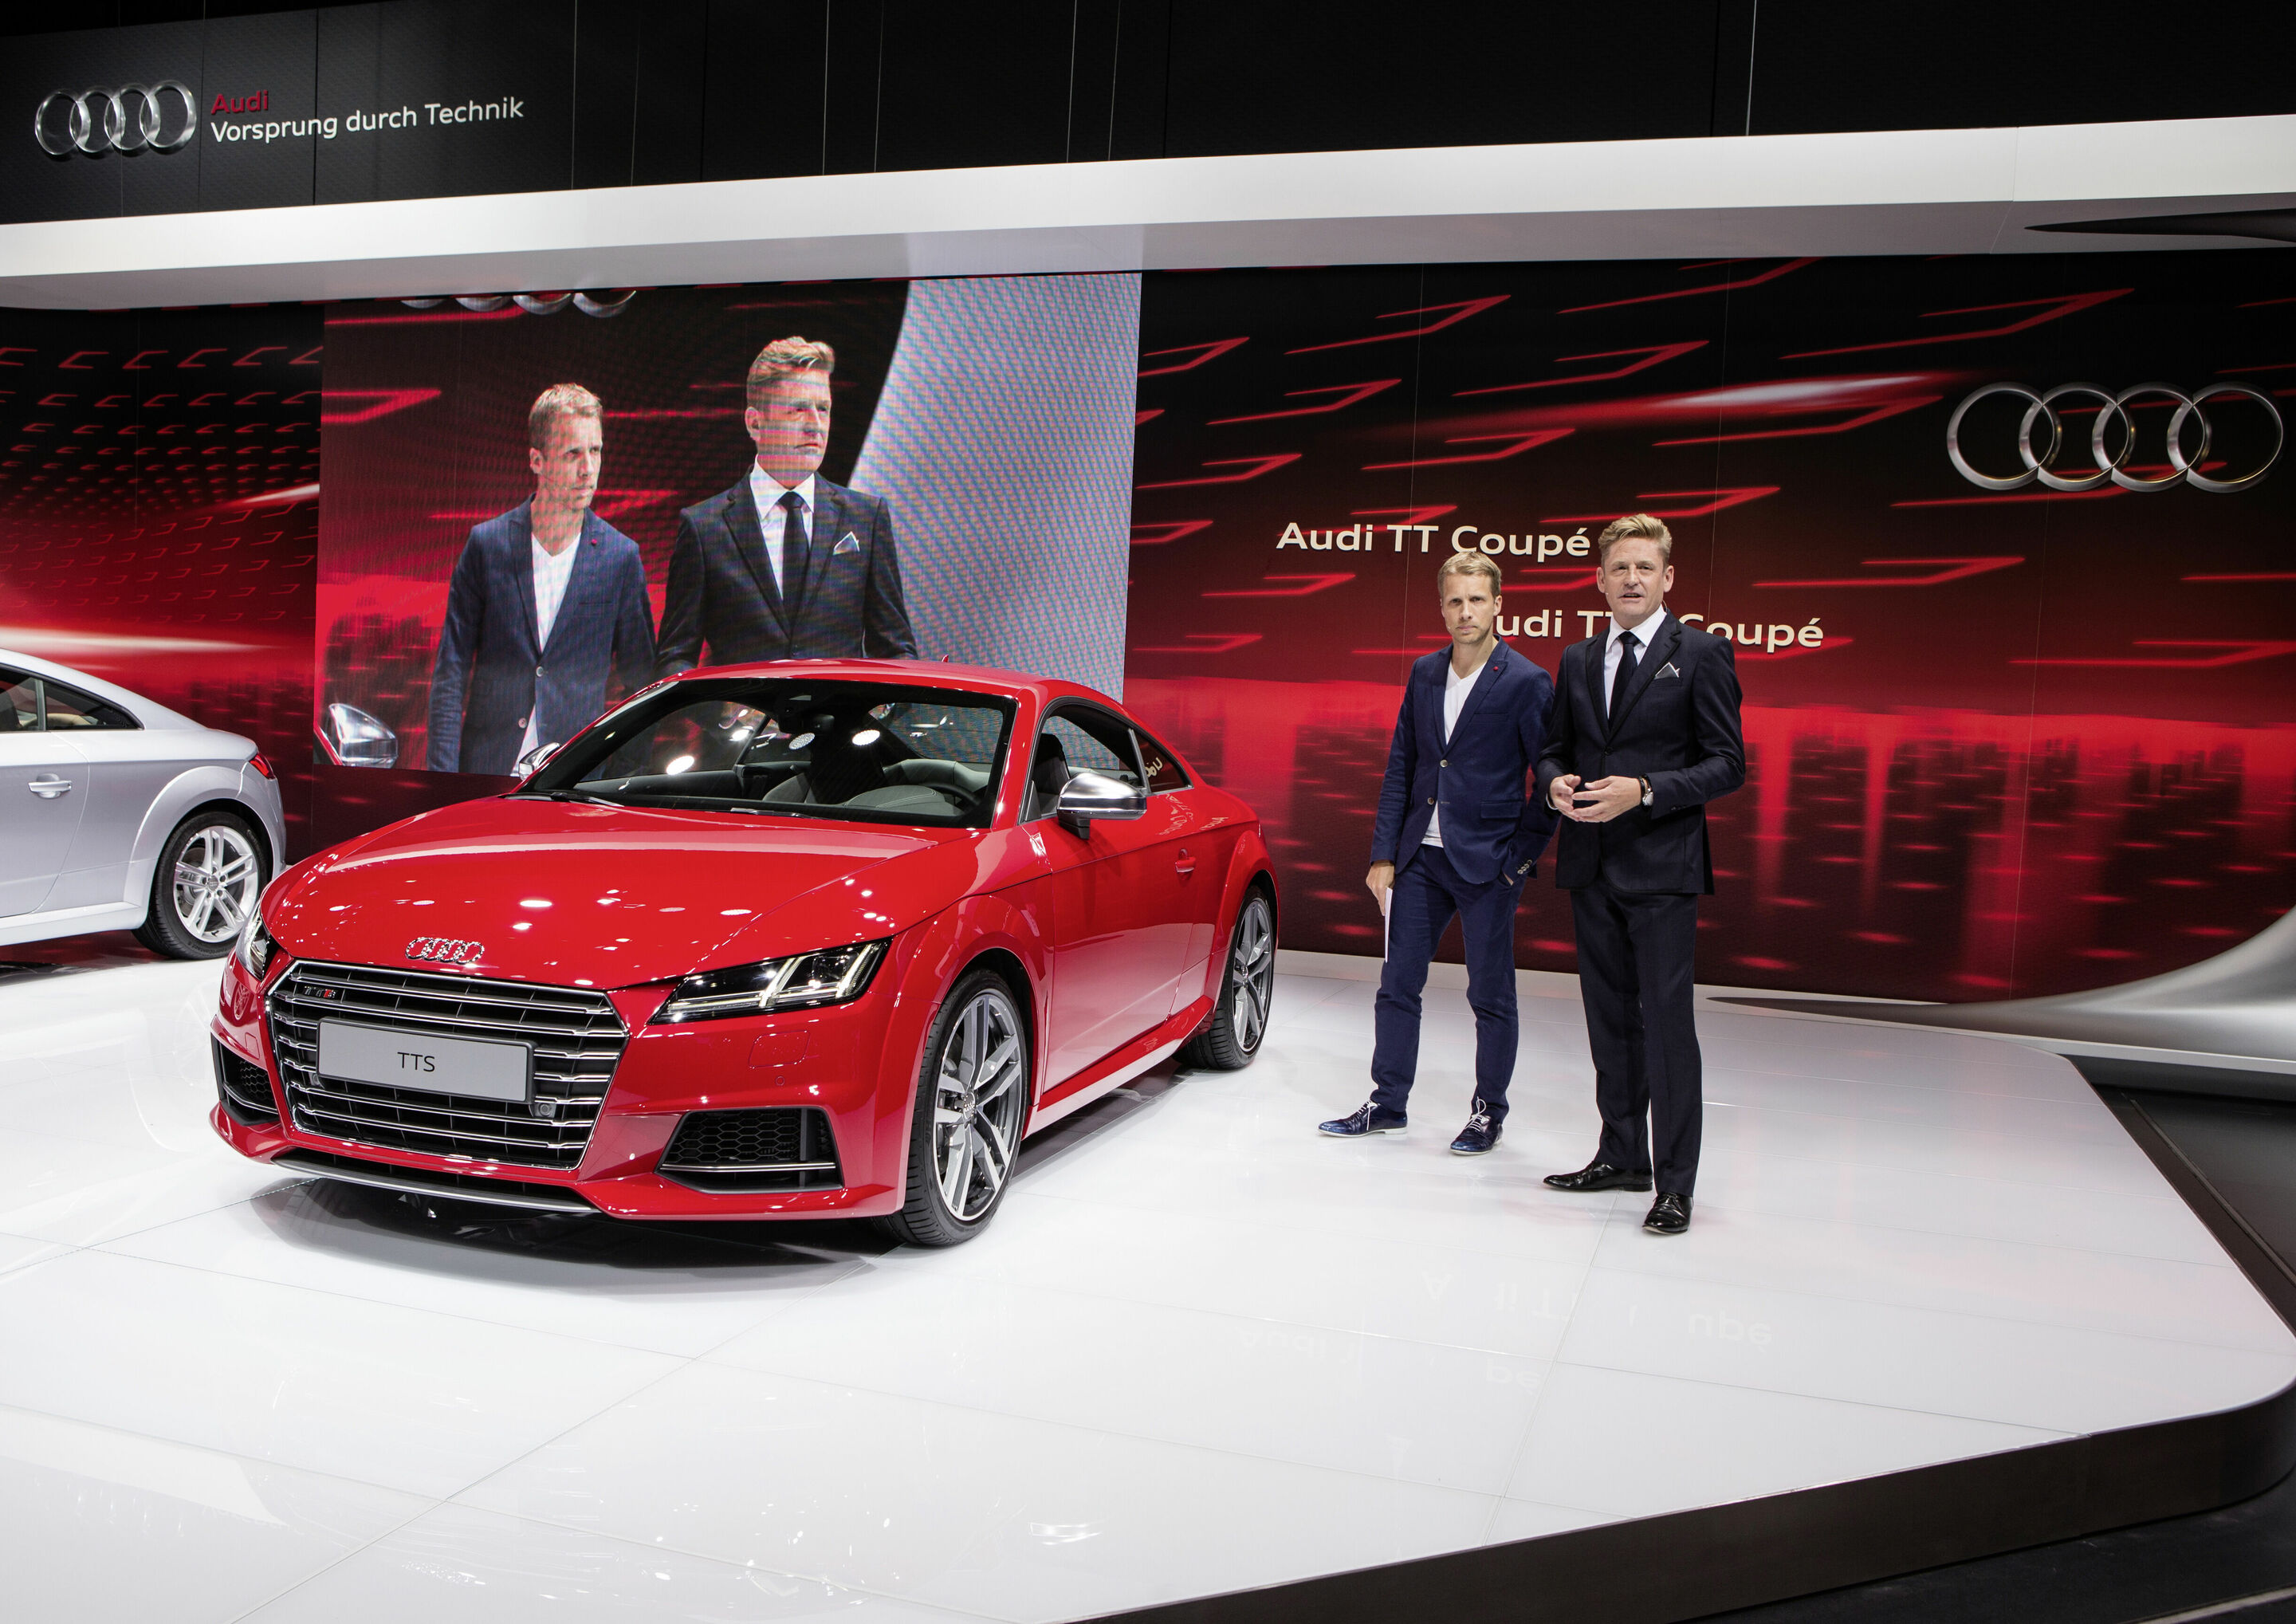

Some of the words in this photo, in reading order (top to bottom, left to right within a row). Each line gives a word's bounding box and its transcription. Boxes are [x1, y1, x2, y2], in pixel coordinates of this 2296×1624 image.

[210, 90, 269, 114] Audi
[210, 117, 338, 144] Vorsprung
[346, 106, 417, 132] durch
[425, 96, 525, 126] Technik
[1276, 522, 1373, 551] Audi
[1387, 525, 1439, 552] TT
[1452, 525, 1590, 562] Coupé
[1496, 609, 1563, 638] udi
[1577, 611, 1613, 638] T
[397, 1052, 435, 1072] TTS
